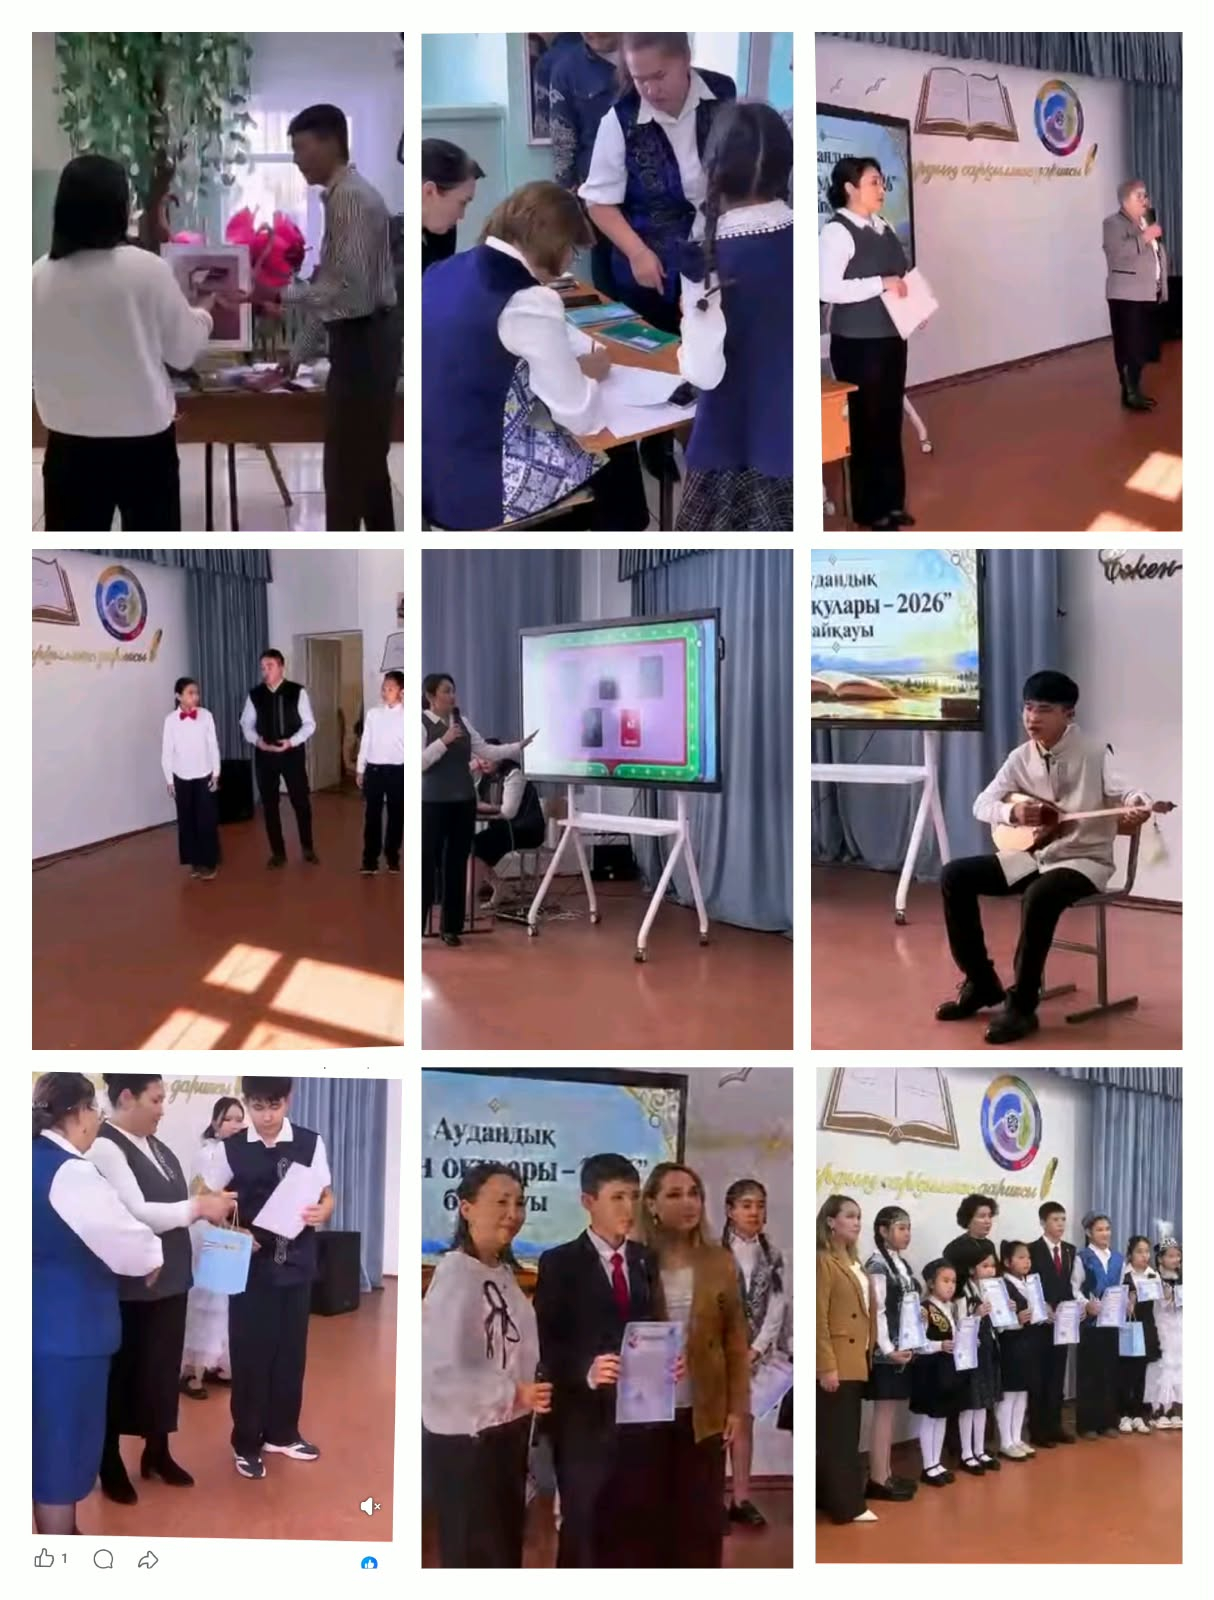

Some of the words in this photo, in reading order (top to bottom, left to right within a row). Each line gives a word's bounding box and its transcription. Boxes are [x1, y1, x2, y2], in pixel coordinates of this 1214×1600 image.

[812, 598, 880, 619] қулары
[897, 592, 952, 613] 2026”
[812, 622, 874, 642] айқауы
[434, 1117, 556, 1148] Аудандық
